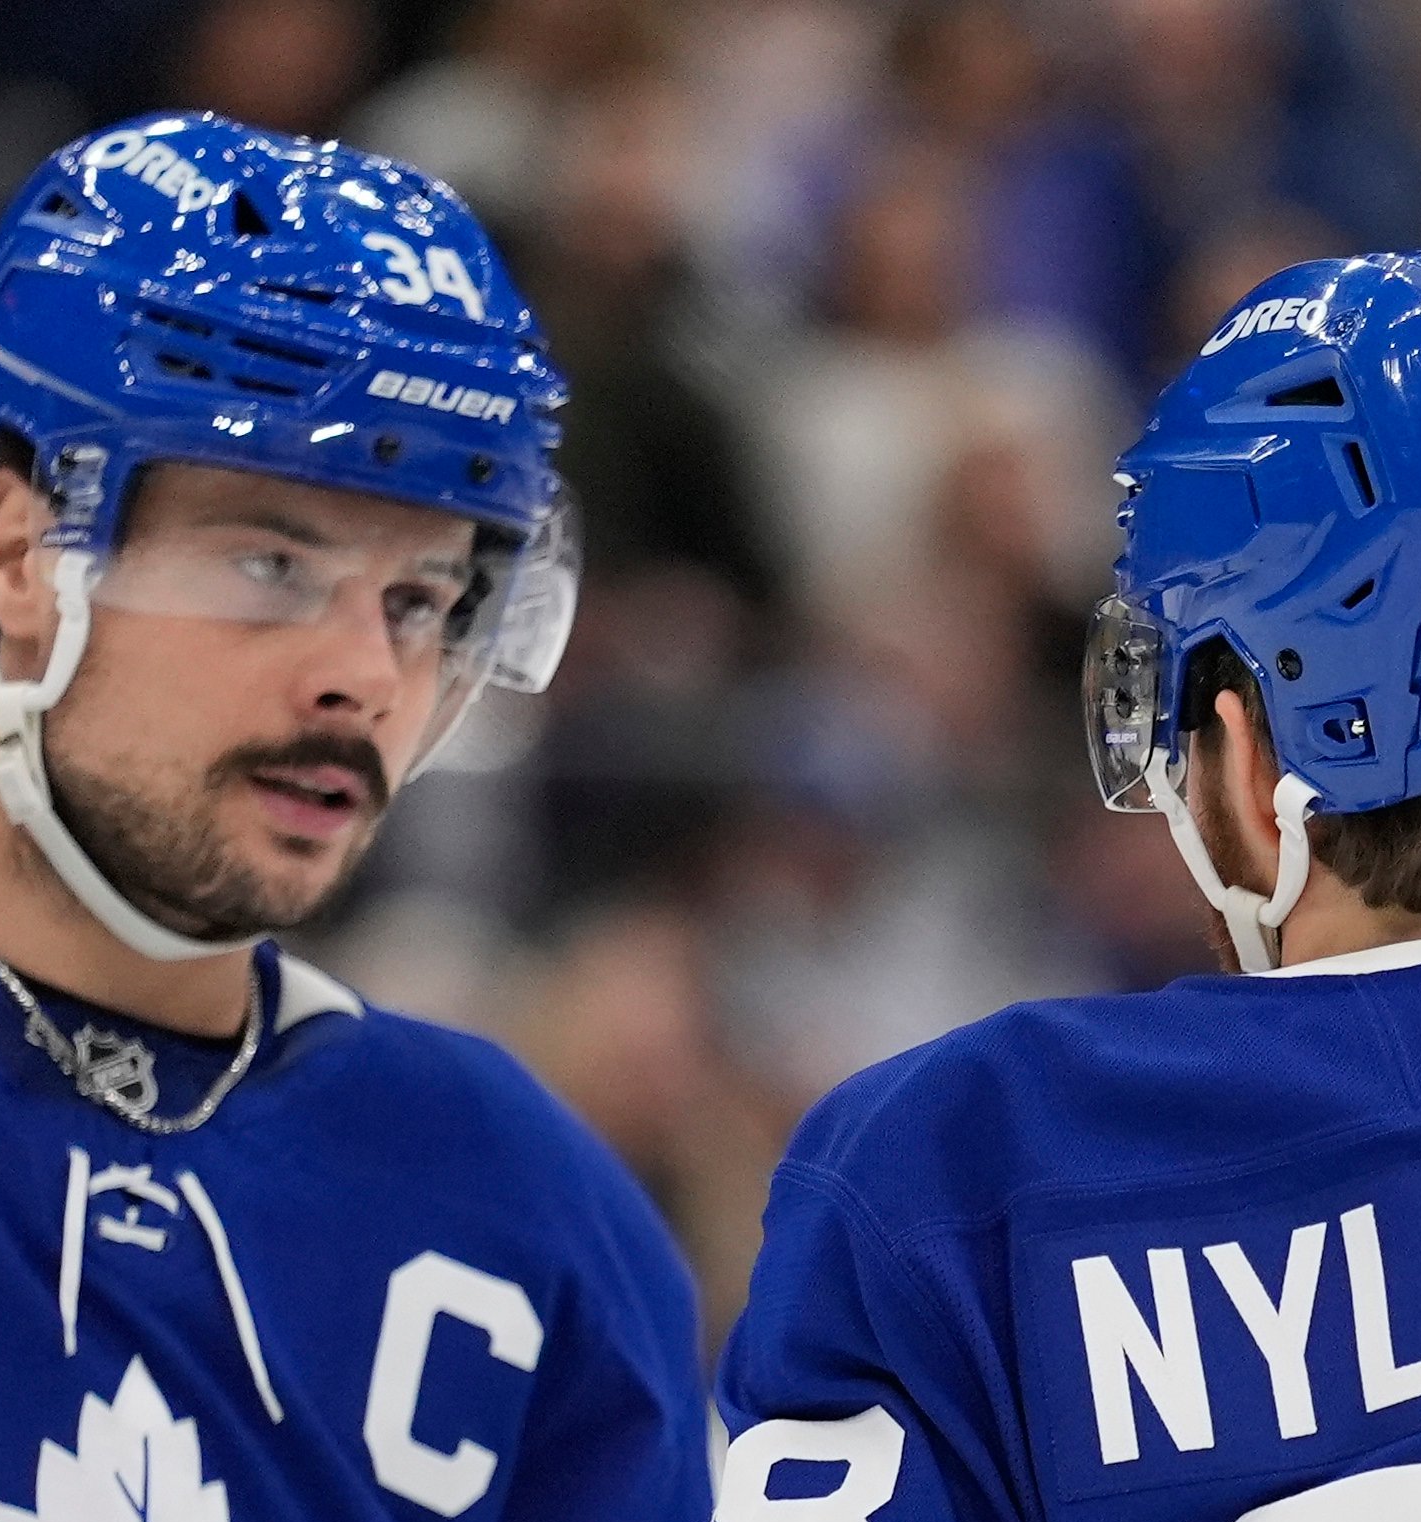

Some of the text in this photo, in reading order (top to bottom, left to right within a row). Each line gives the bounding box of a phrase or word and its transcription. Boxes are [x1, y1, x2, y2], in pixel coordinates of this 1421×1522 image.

[79, 130, 217, 213] OREO
[361, 231, 486, 322] 34
[1200, 297, 1328, 357] OREO
[366, 370, 518, 425] BAUER
[1104, 732, 1139, 745] BAUER
[363, 1249, 544, 1519] C
